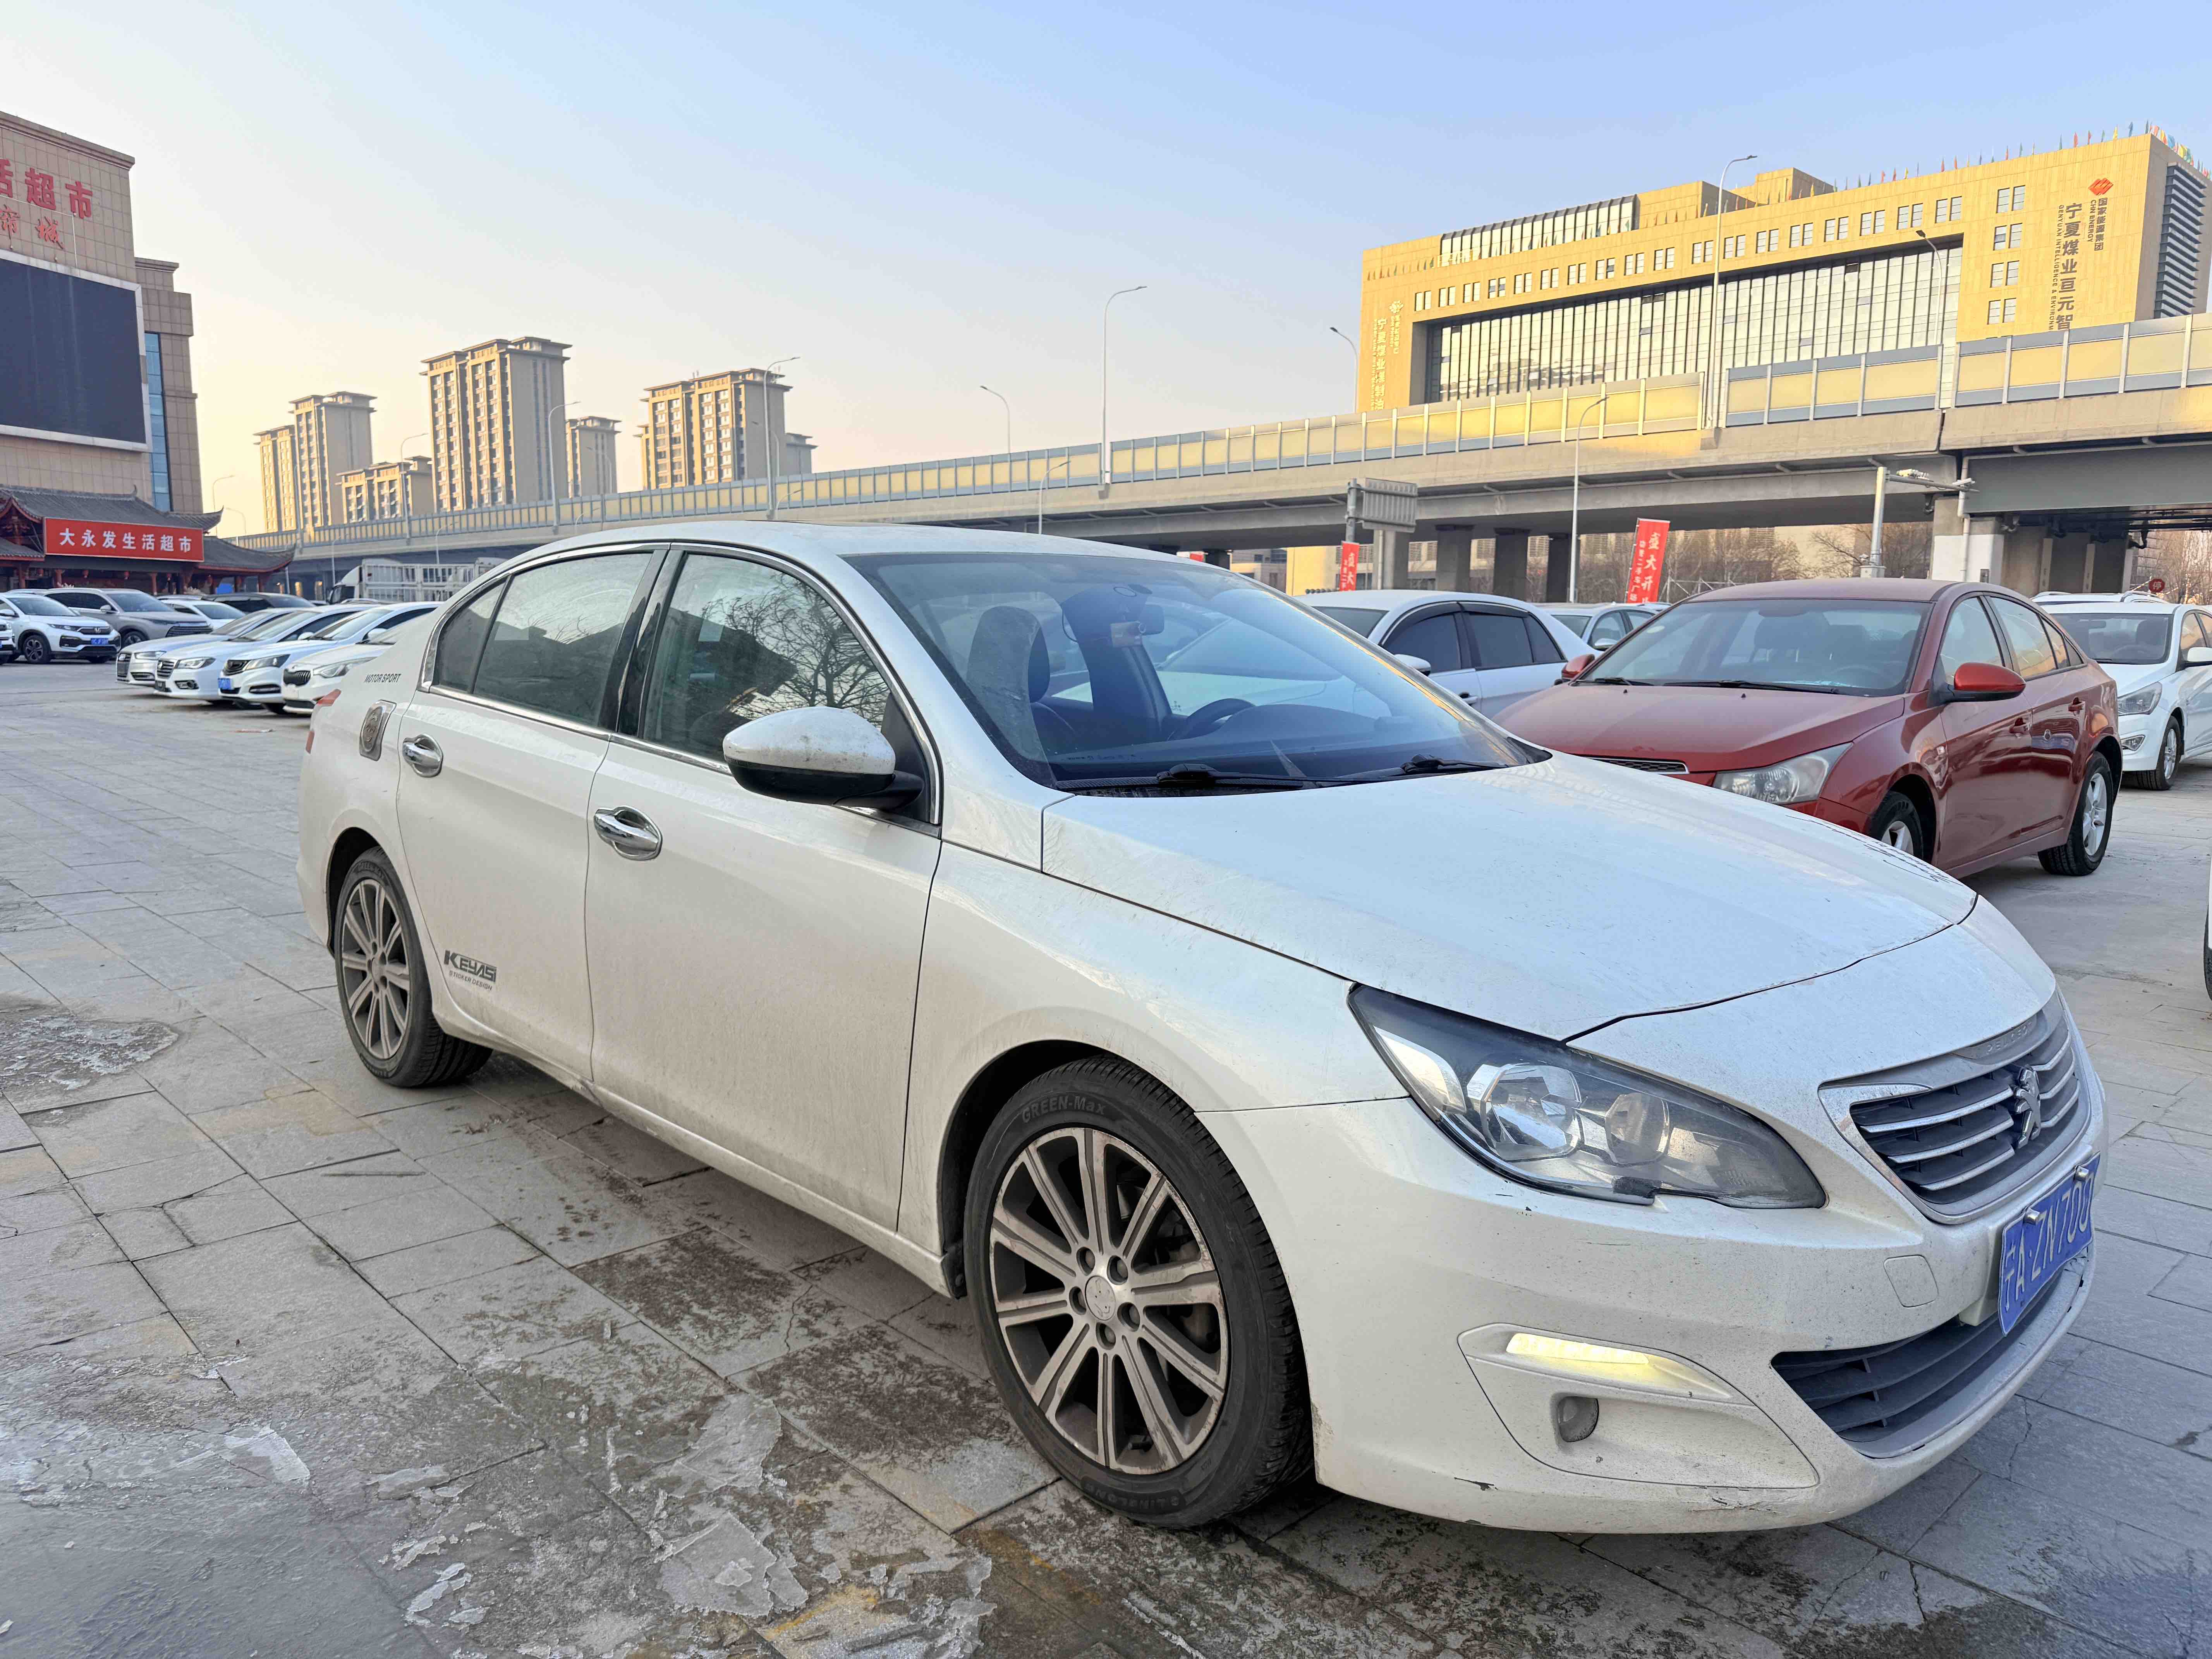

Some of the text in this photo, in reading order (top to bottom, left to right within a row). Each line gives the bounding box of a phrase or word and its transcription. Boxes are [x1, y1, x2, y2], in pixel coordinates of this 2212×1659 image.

[2087, 215, 2095, 242] ENERGY
[2052, 239, 2061, 287] INTELLIGENCE
[59, 528, 192, 553] 大永发生活超市
[2153, 581, 2161, 589] 停
[364, 673, 402, 682] MOTOR SPORT
[449, 969, 493, 991] STICKER DESIGN
[1022, 1096, 1106, 1123] GREEN-Max
